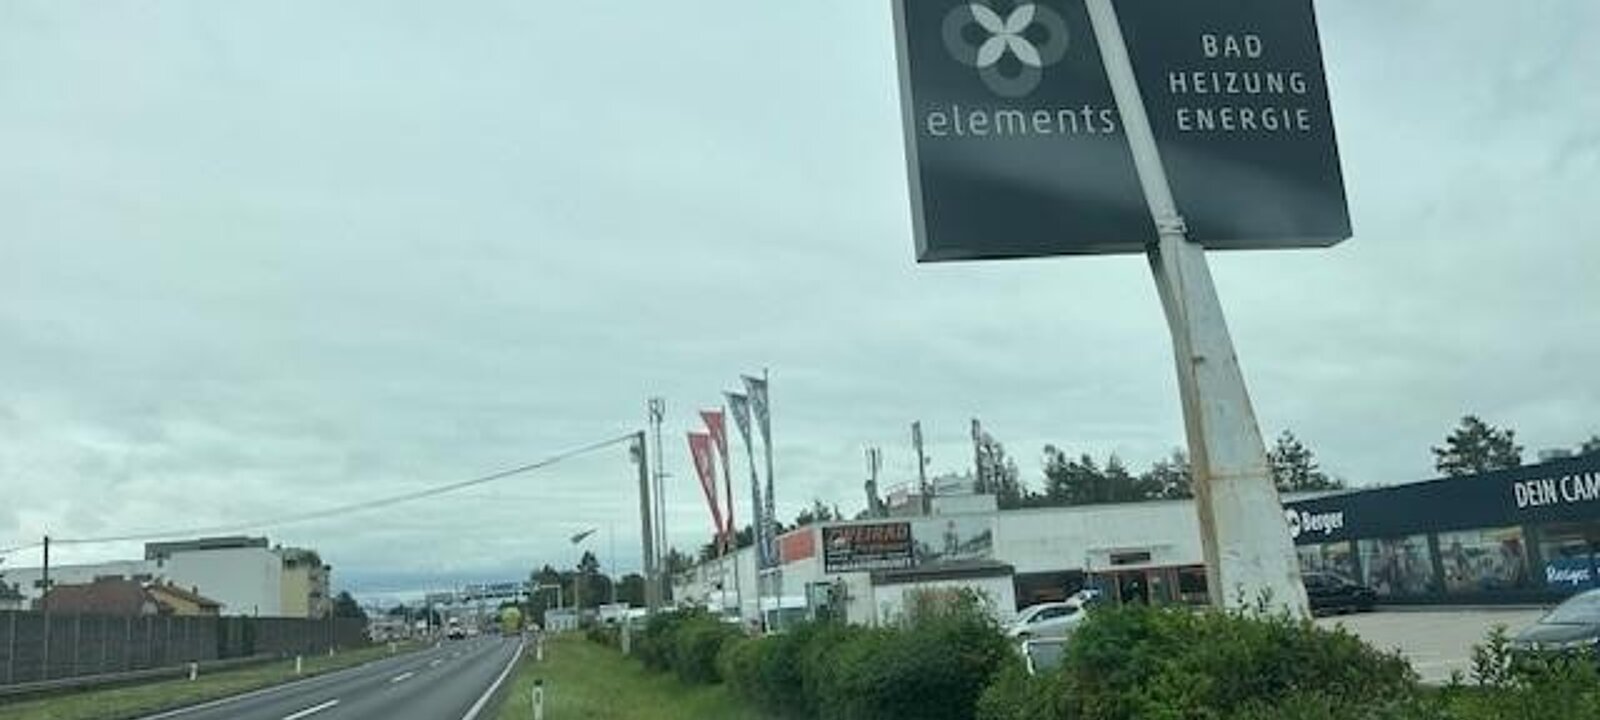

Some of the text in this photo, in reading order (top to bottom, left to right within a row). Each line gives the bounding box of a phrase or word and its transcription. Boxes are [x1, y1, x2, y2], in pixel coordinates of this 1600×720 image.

[1201, 33, 1262, 59] BAD
[1168, 71, 1307, 94] HEIZUNG
[926, 104, 1116, 136] elements
[1176, 107, 1312, 131] ENERGIE
[1514, 479, 1558, 508] DEIN
[1301, 510, 1344, 535] Berger
